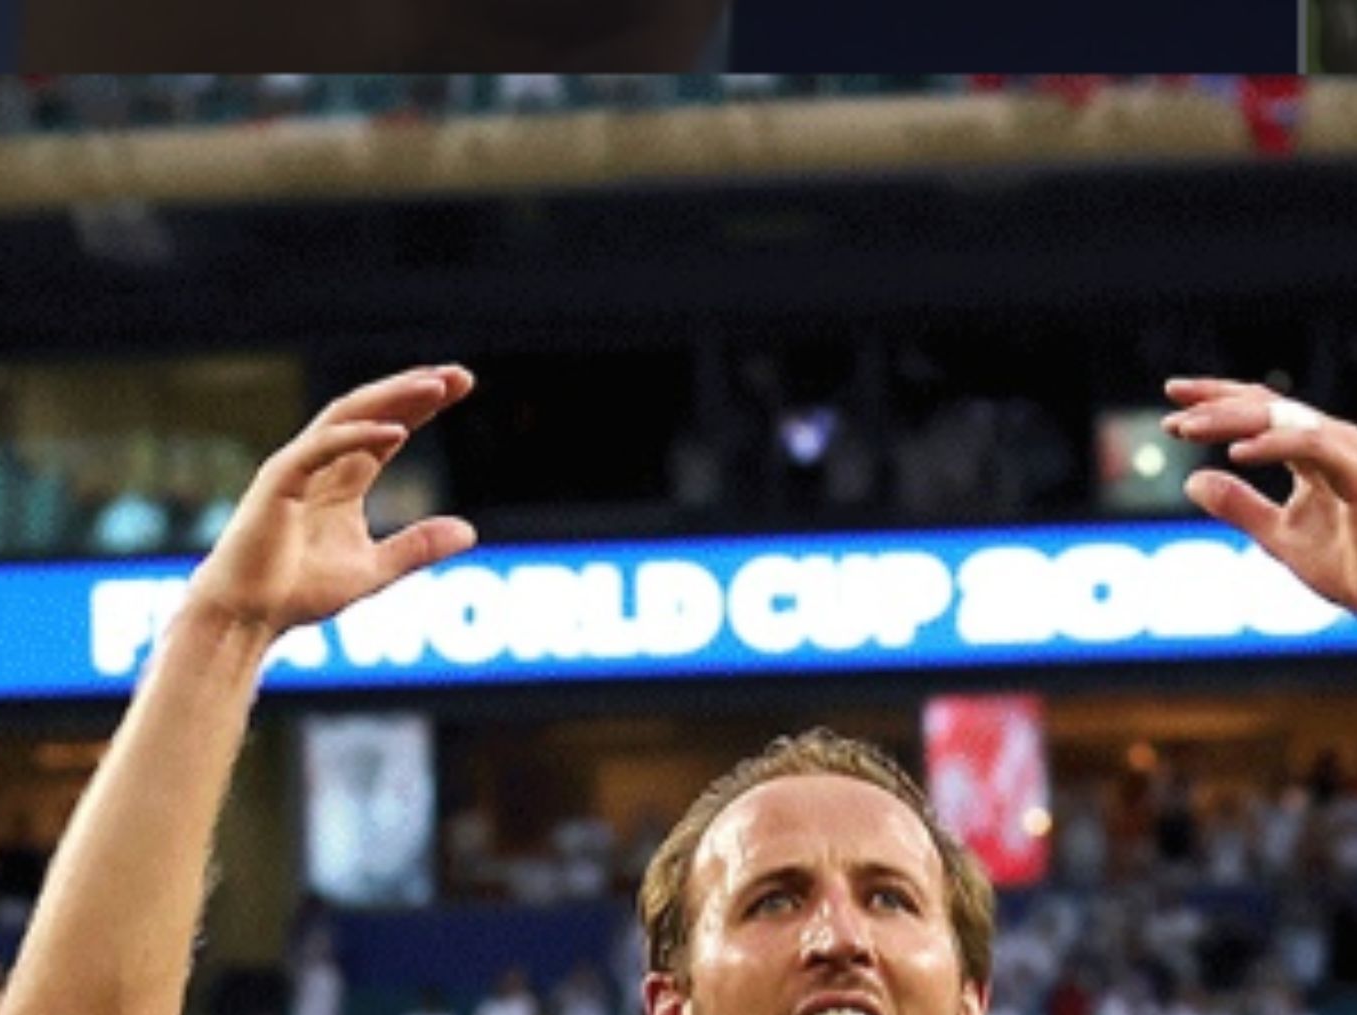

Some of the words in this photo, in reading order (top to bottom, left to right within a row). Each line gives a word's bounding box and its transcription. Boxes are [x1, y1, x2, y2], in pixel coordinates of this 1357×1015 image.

[90, 577, 329, 676] FIA
[335, 559, 724, 666] WORLD
[728, 550, 953, 654] CUP
